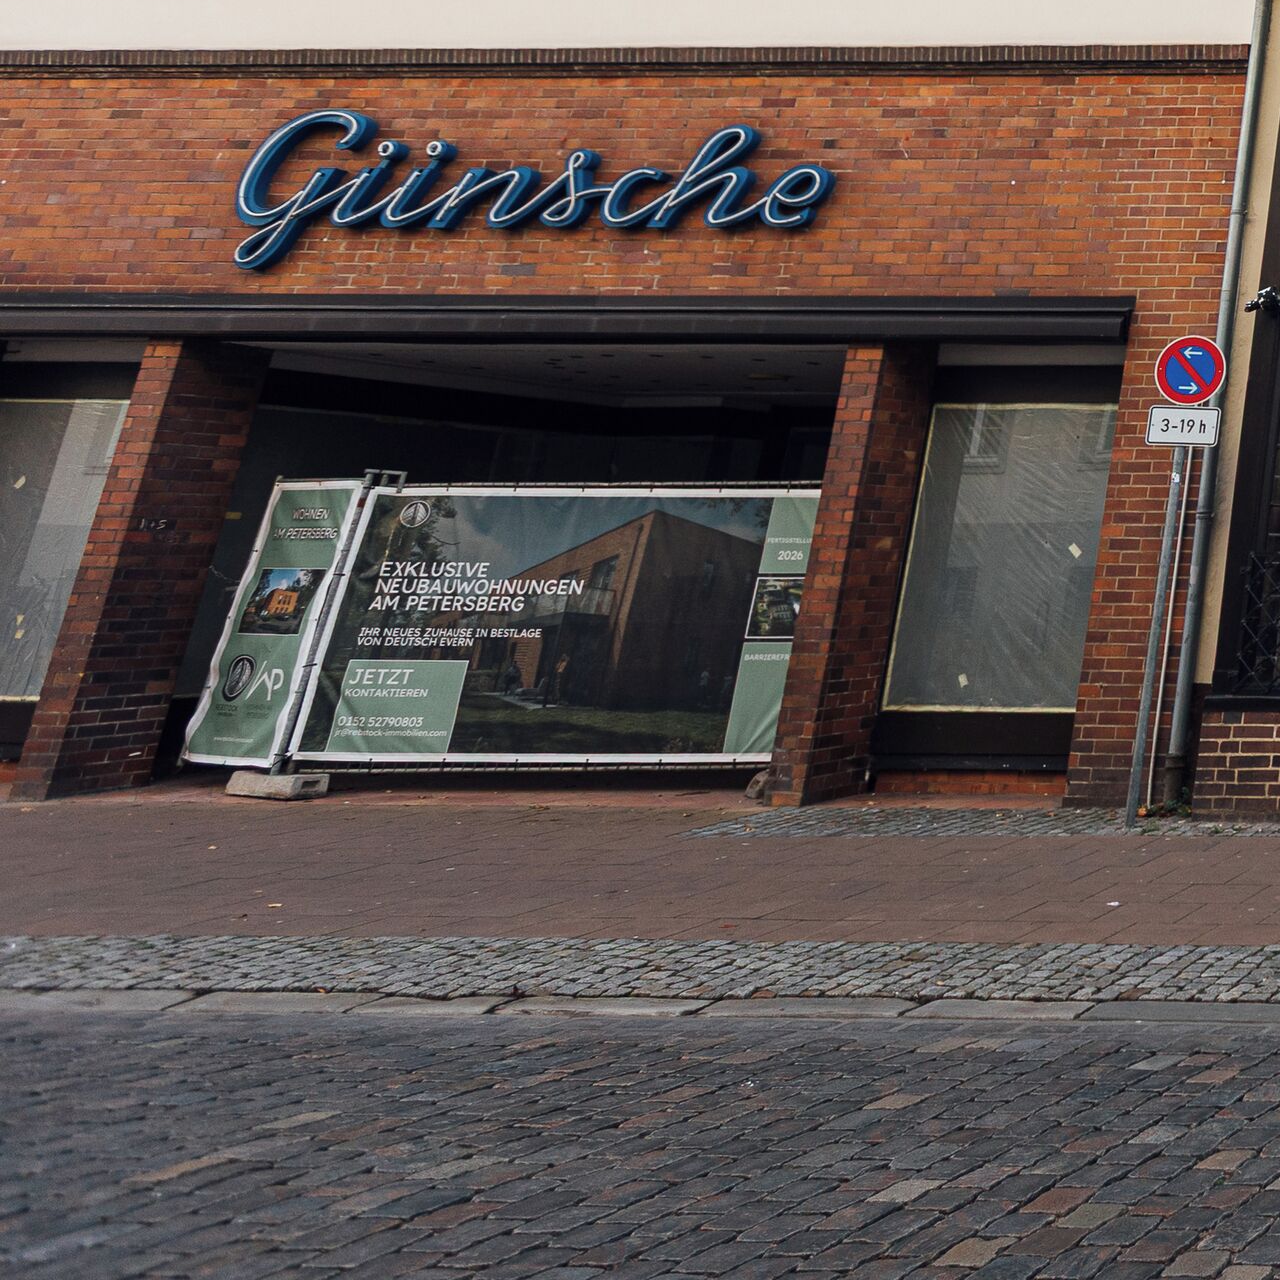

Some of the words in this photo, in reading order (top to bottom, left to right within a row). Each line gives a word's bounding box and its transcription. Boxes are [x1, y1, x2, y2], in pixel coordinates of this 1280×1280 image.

[234, 107, 834, 271] Günsche
[1160, 418, 1196, 434] 3-19
[1198, 419, 1207, 434] h
[292, 508, 330, 520] WOHNEN
[286, 527, 338, 539] PETERSBERG
[777, 550, 804, 561] 2026
[379, 562, 490, 578] EXKLUSIVE
[374, 579, 585, 595] NEUBAUWOHNUNGEN
[368, 596, 400, 611] AM
[405, 596, 526, 612] PETERSBERG
[358, 627, 380, 637] IHR
[382, 628, 421, 638] NEUES
[423, 628, 473, 638] ZUHAUSE
[475, 628, 488, 638] IN
[489, 628, 542, 638] BESTLAGE
[357, 637, 382, 646] VON
[384, 637, 438, 647] DEUTSCH
[439, 638, 474, 647] EVERN
[349, 669, 414, 685] JETZT
[344, 688, 428, 698] KONTAKTIEREN
[337, 716, 365, 727] 0152
[367, 717, 424, 728] 52790803
